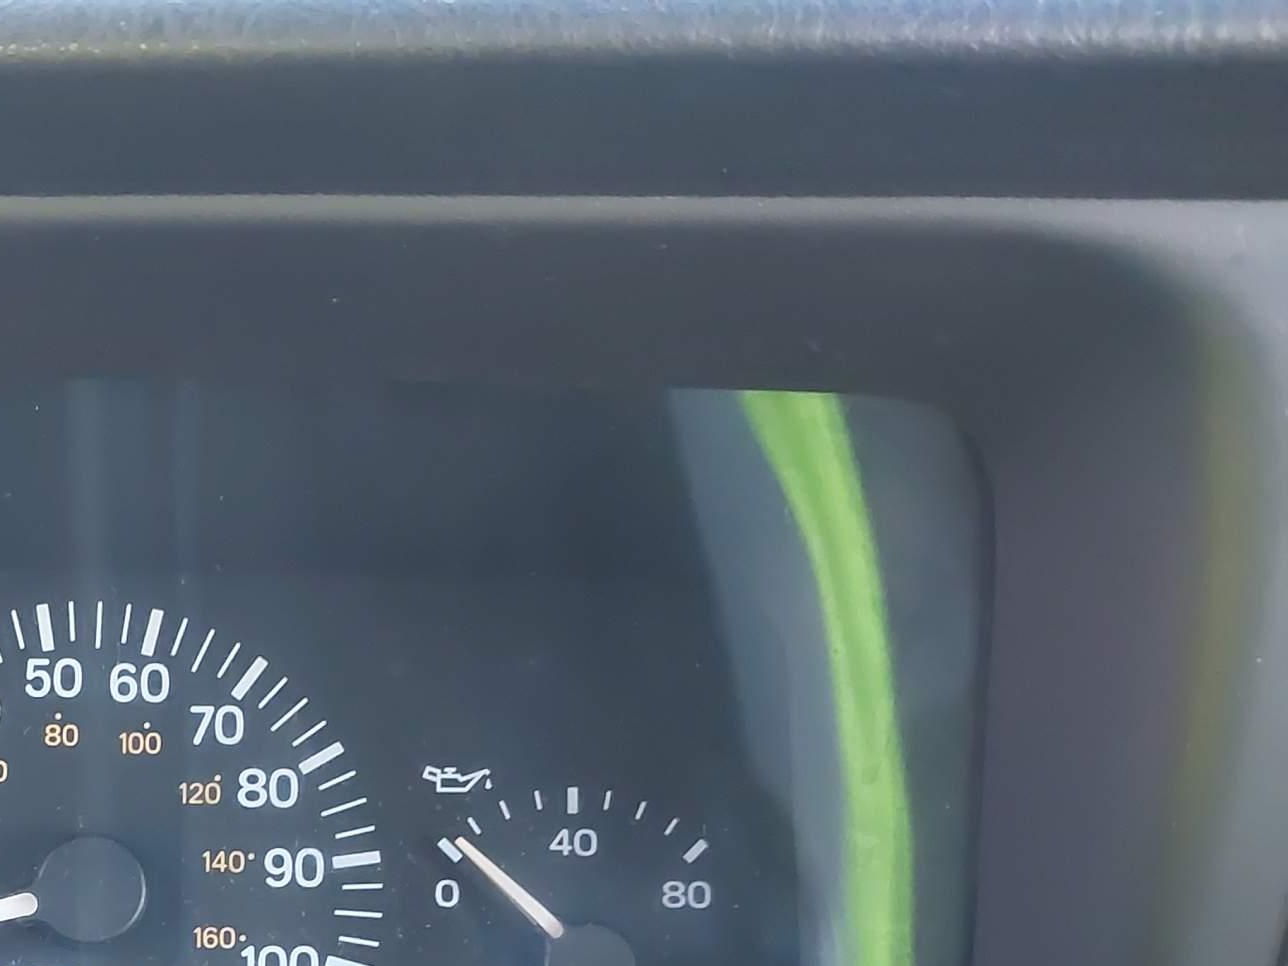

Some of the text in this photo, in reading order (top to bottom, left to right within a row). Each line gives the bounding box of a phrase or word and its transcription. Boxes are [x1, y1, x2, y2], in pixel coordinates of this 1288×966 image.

[25, 658, 83, 698] 50
[110, 663, 170, 702] 60
[44, 724, 79, 746] 80
[190, 705, 245, 745] 70
[119, 732, 162, 754] 100
[179, 782, 220, 804] 120
[237, 768, 299, 807] 80
[549, 829, 598, 857] 40
[202, 851, 245, 872] 140
[264, 848, 325, 888] 90
[434, 880, 460, 908] 0
[662, 881, 712, 908] 80
[193, 927, 236, 949] 160
